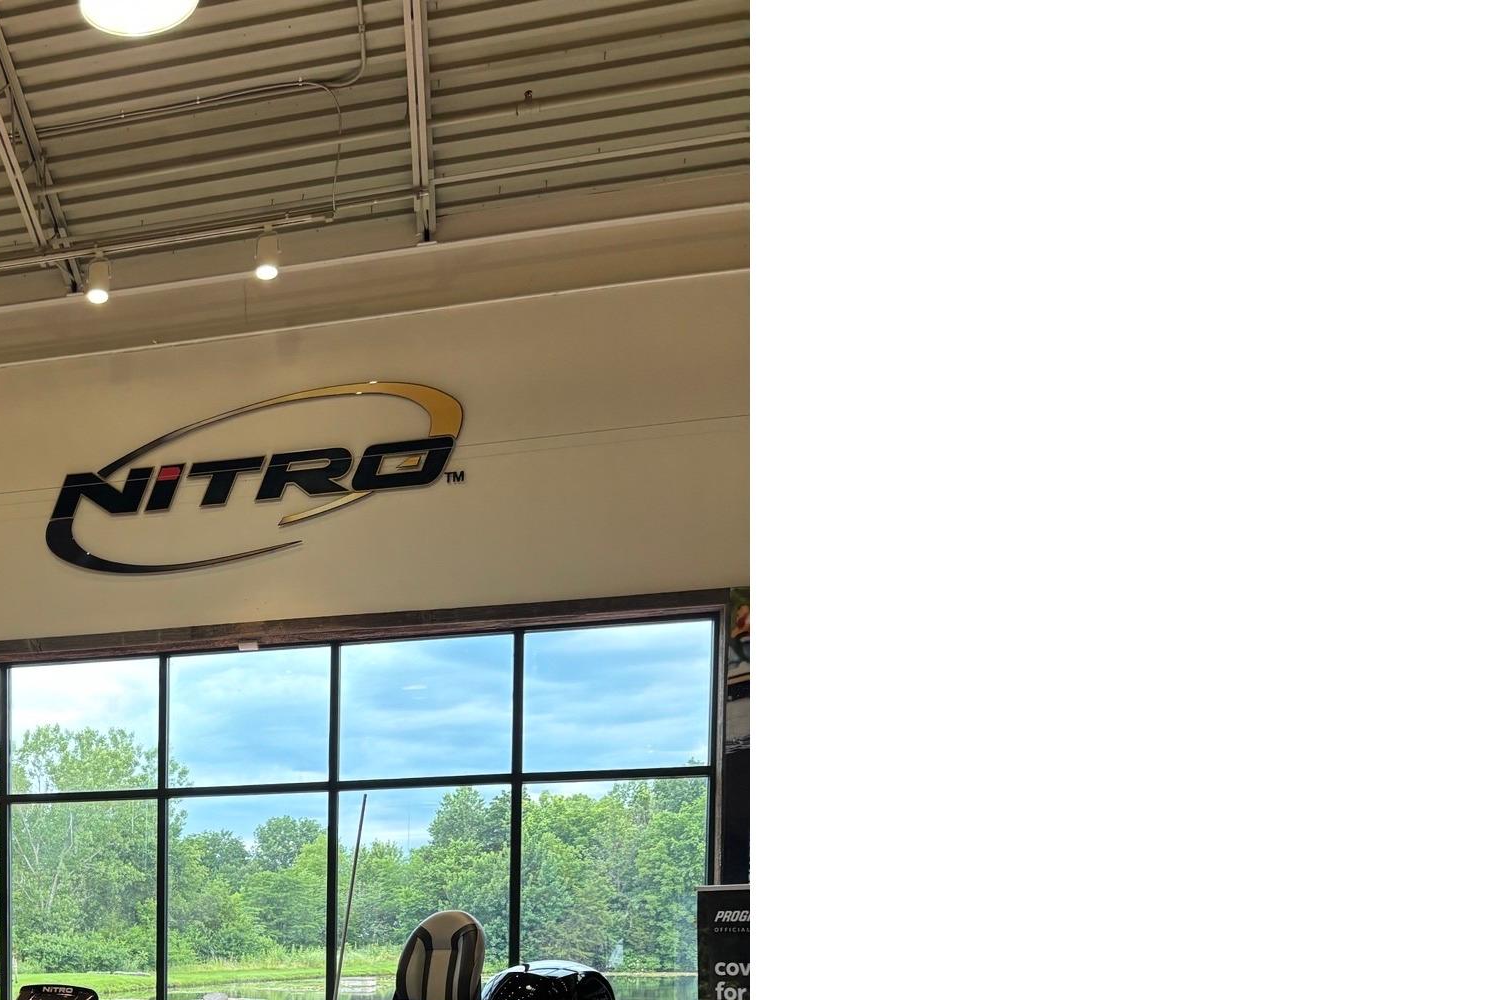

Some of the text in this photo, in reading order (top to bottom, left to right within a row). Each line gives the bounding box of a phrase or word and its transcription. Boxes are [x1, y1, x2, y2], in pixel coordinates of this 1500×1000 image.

[714, 910, 750, 923] PROG
[42, 986, 74, 994] NITRO
[715, 981, 747, 1000] for
